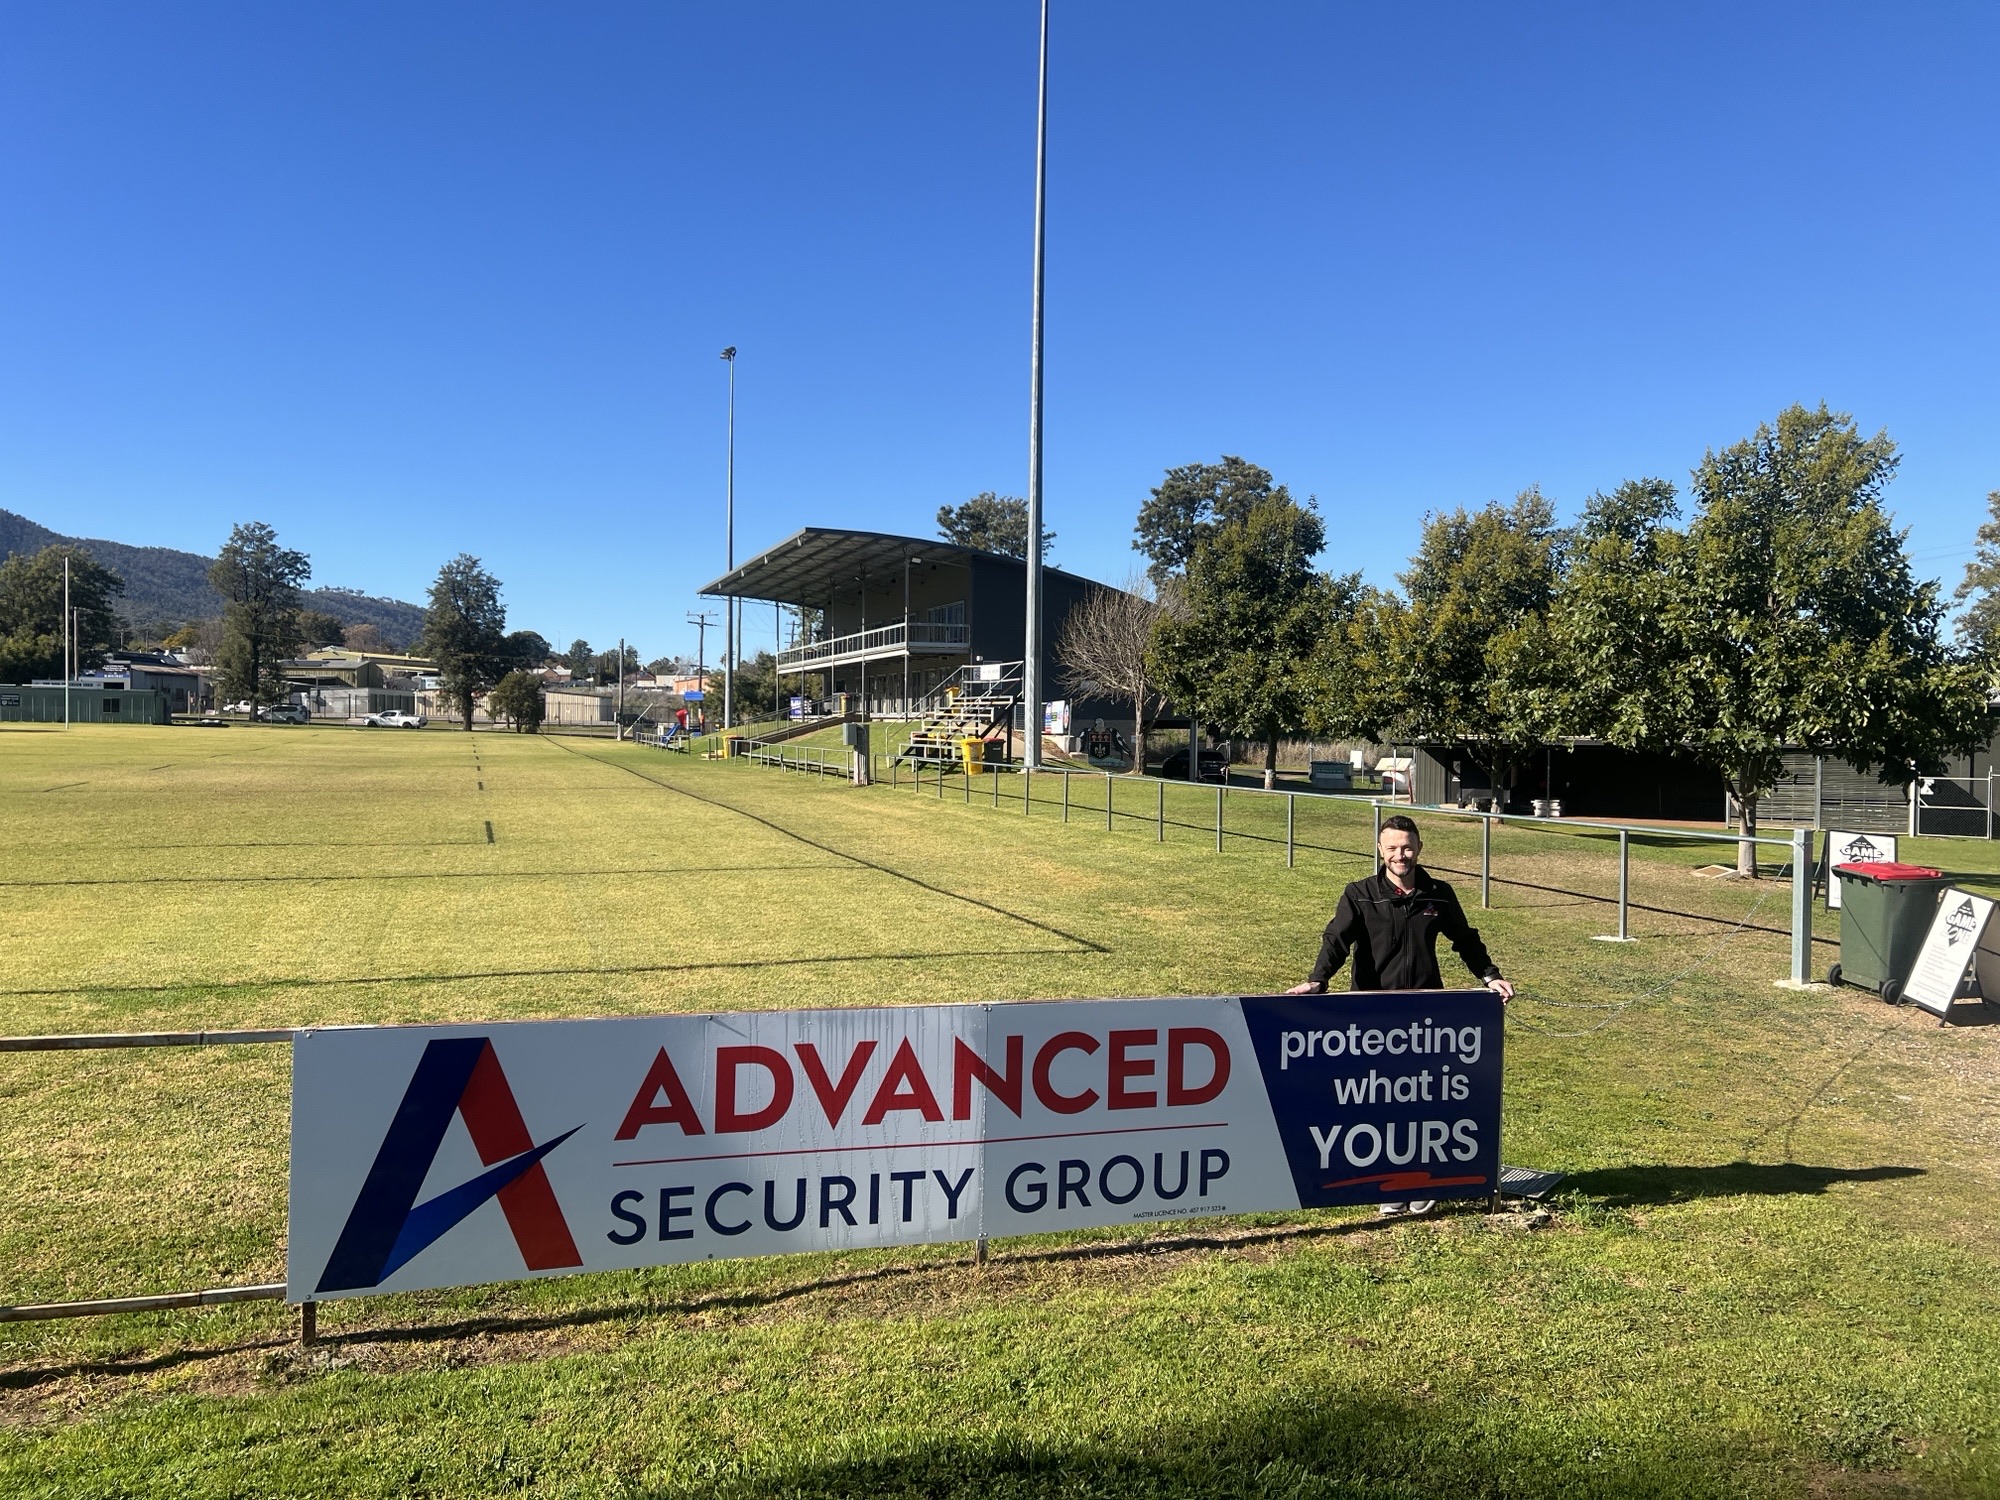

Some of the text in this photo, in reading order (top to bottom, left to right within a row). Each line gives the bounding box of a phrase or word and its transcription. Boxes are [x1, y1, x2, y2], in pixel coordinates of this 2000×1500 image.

[1840, 846, 1884, 858] GAME
[1945, 910, 1977, 932] GAME
[1280, 1017, 1482, 1070] protecting
[613, 1027, 1231, 1141] ADVANCED
[1334, 1065, 1470, 1105] what is
[1309, 1118, 1480, 1170] YOURS
[606, 1148, 1231, 1246] SECURITY GROUP
[1133, 1211, 1154, 1219] MASTER
[1154, 1209, 1176, 1217] LICENCE
